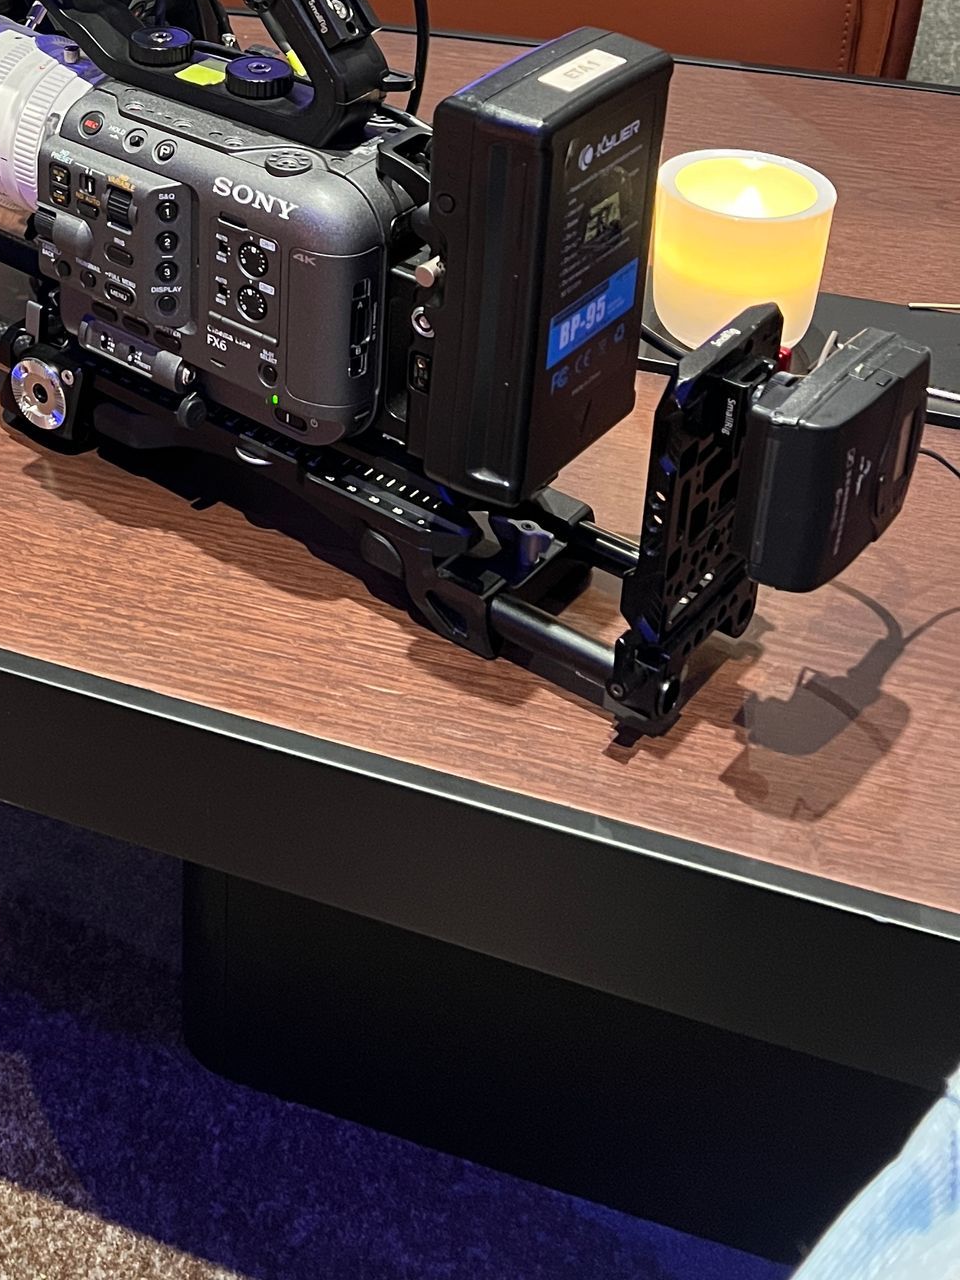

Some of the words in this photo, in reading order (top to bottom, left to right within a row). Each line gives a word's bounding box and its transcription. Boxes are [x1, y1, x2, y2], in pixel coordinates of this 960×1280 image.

[308, 0, 328, 34] SmallRig
[159, 145, 170, 157] P
[212, 176, 299, 220] SONY
[164, 207, 170, 217] 1
[164, 238, 171, 246] 2
[293, 253, 316, 266] 4K
[164, 268, 171, 276] 3
[559, 294, 607, 350] BP-95
[207, 334, 227, 351] FX6
[721, 397, 737, 436] SmallRig
